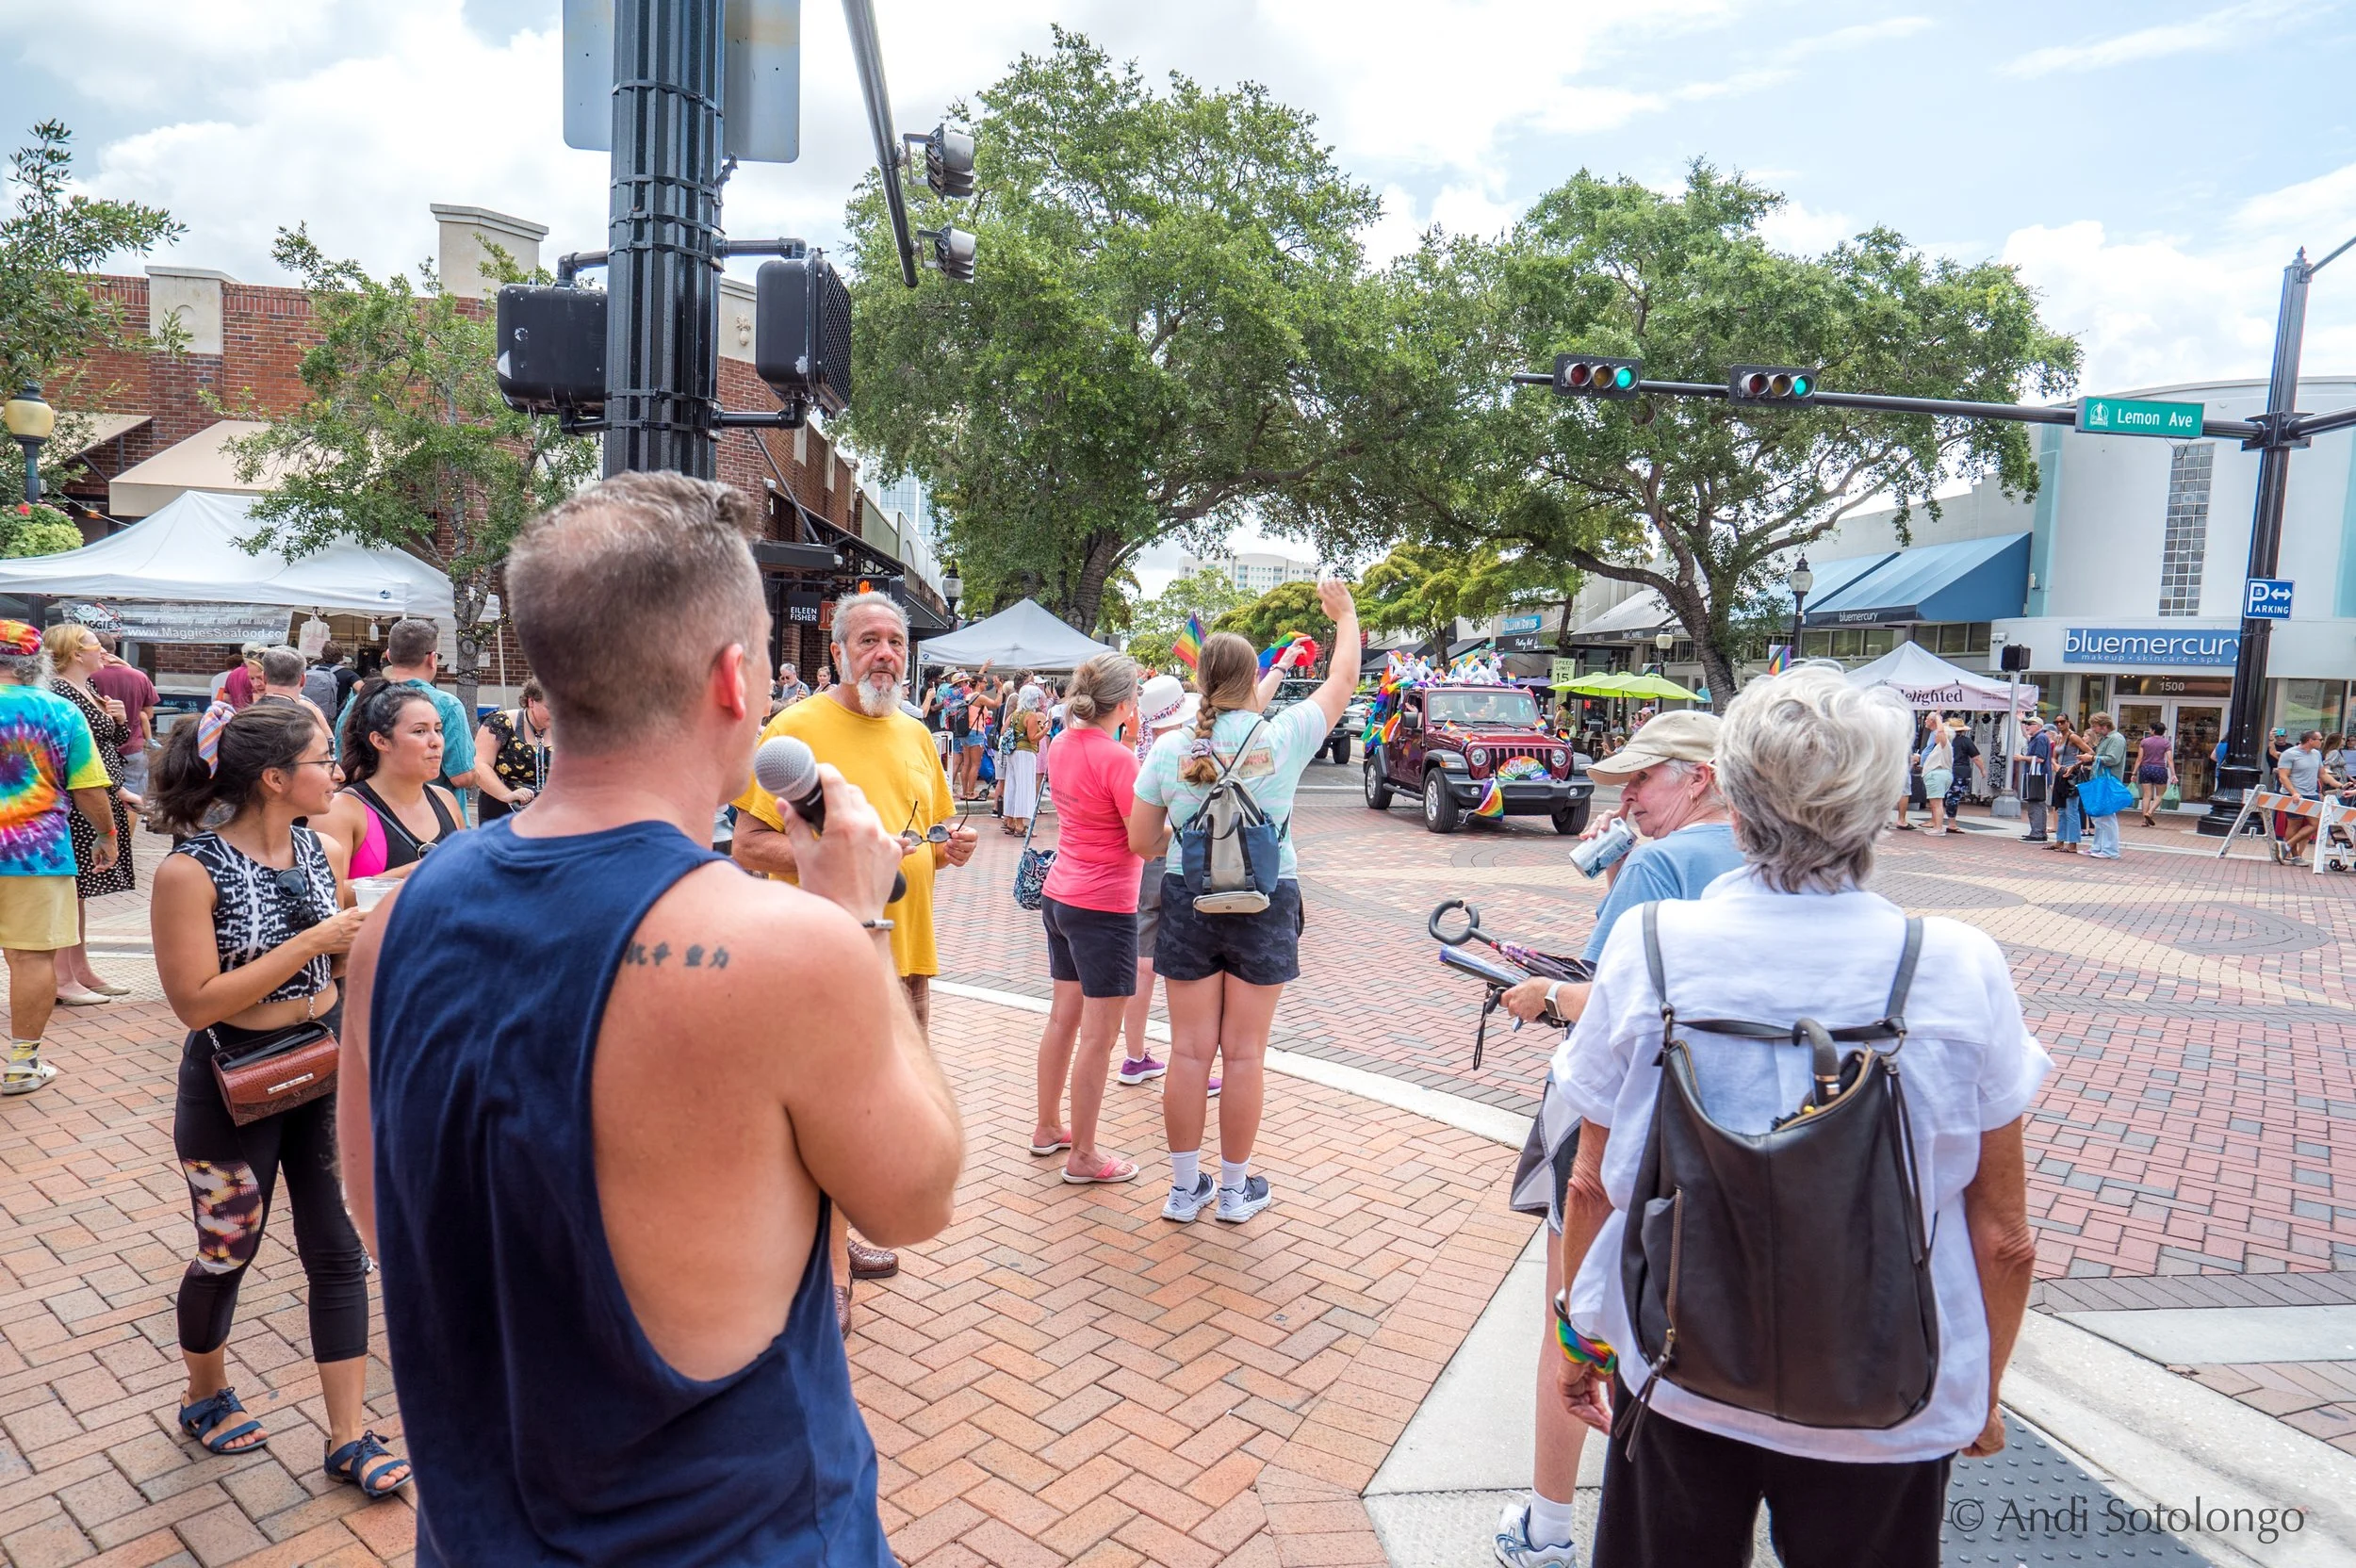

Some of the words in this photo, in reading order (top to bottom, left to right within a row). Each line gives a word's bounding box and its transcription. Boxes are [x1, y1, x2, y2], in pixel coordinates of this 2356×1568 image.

[2118, 408, 2160, 425] Lemon
[2168, 411, 2193, 428] Ave
[790, 606, 817, 614] EILEEN
[790, 613, 817, 622] FISHER
[1839, 612, 1878, 622] bluemercury
[127, 627, 286, 639] www.MaggiesSeafood.co
[2082, 654, 2125, 662] makeup
[1556, 673, 1569, 682] 15
[2159, 681, 2185, 692] 1500
[1505, 761, 1539, 774] PROUD
